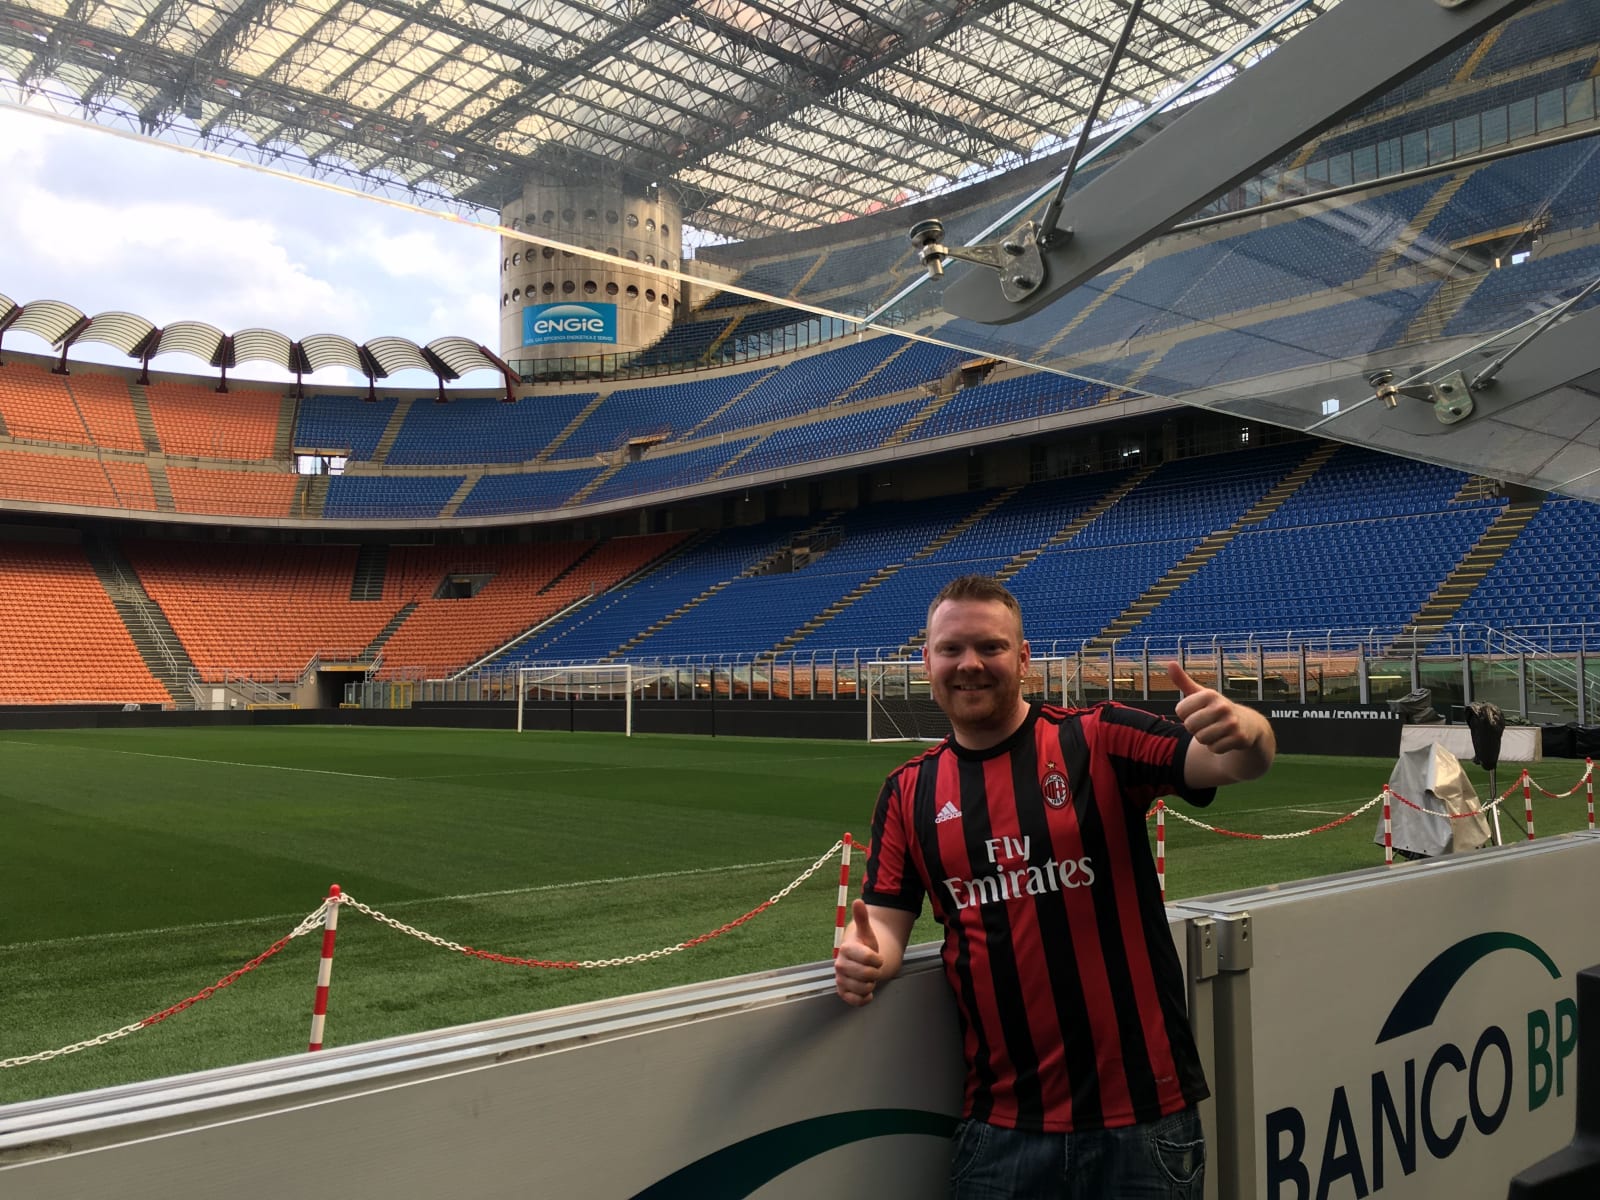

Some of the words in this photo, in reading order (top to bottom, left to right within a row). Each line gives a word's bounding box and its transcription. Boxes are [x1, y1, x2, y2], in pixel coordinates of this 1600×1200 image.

[985, 836, 1030, 863] Fly
[942, 857, 1095, 910] Emirates
[1266, 1026, 1513, 1200] BANCO
